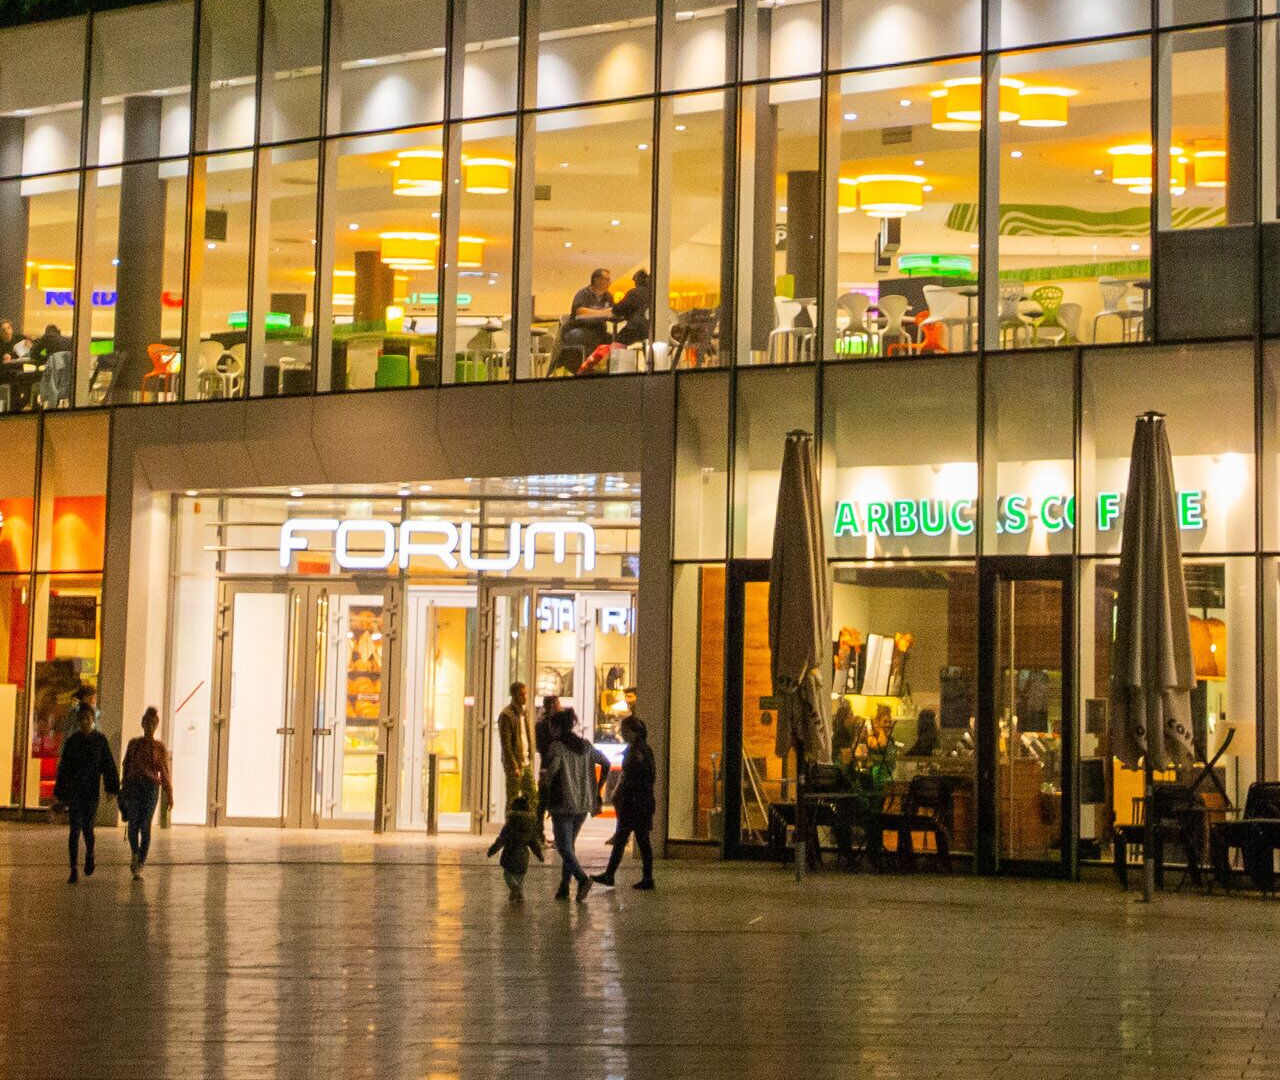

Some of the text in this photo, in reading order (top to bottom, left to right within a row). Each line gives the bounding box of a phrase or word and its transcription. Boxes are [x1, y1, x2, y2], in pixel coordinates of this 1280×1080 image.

[833, 489, 1204, 538] ARBUCS CFE
[279, 518, 596, 572] FORUM
